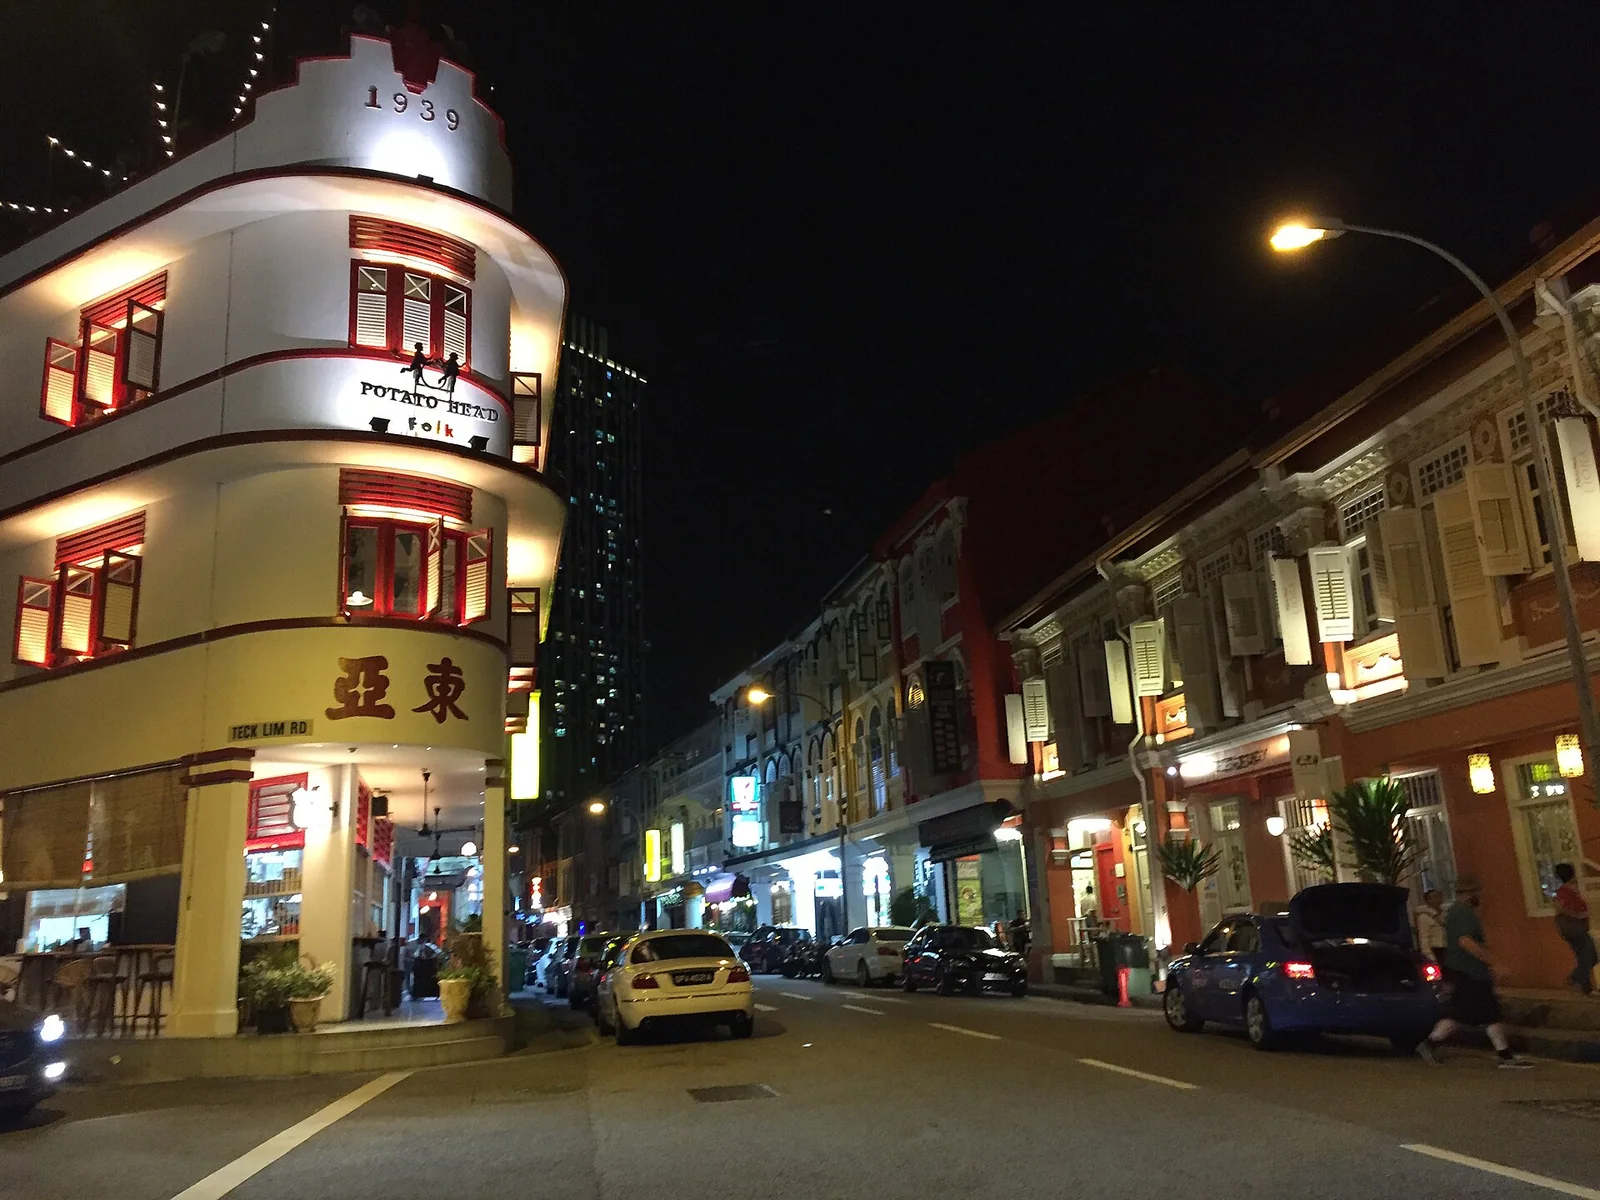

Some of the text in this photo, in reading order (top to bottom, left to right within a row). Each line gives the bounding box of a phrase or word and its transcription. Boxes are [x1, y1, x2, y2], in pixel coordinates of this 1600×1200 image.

[364, 85, 460, 131] 1939
[360, 381, 499, 422] POTATO HEAD
[232, 721, 307, 741] TECK LIM RD
